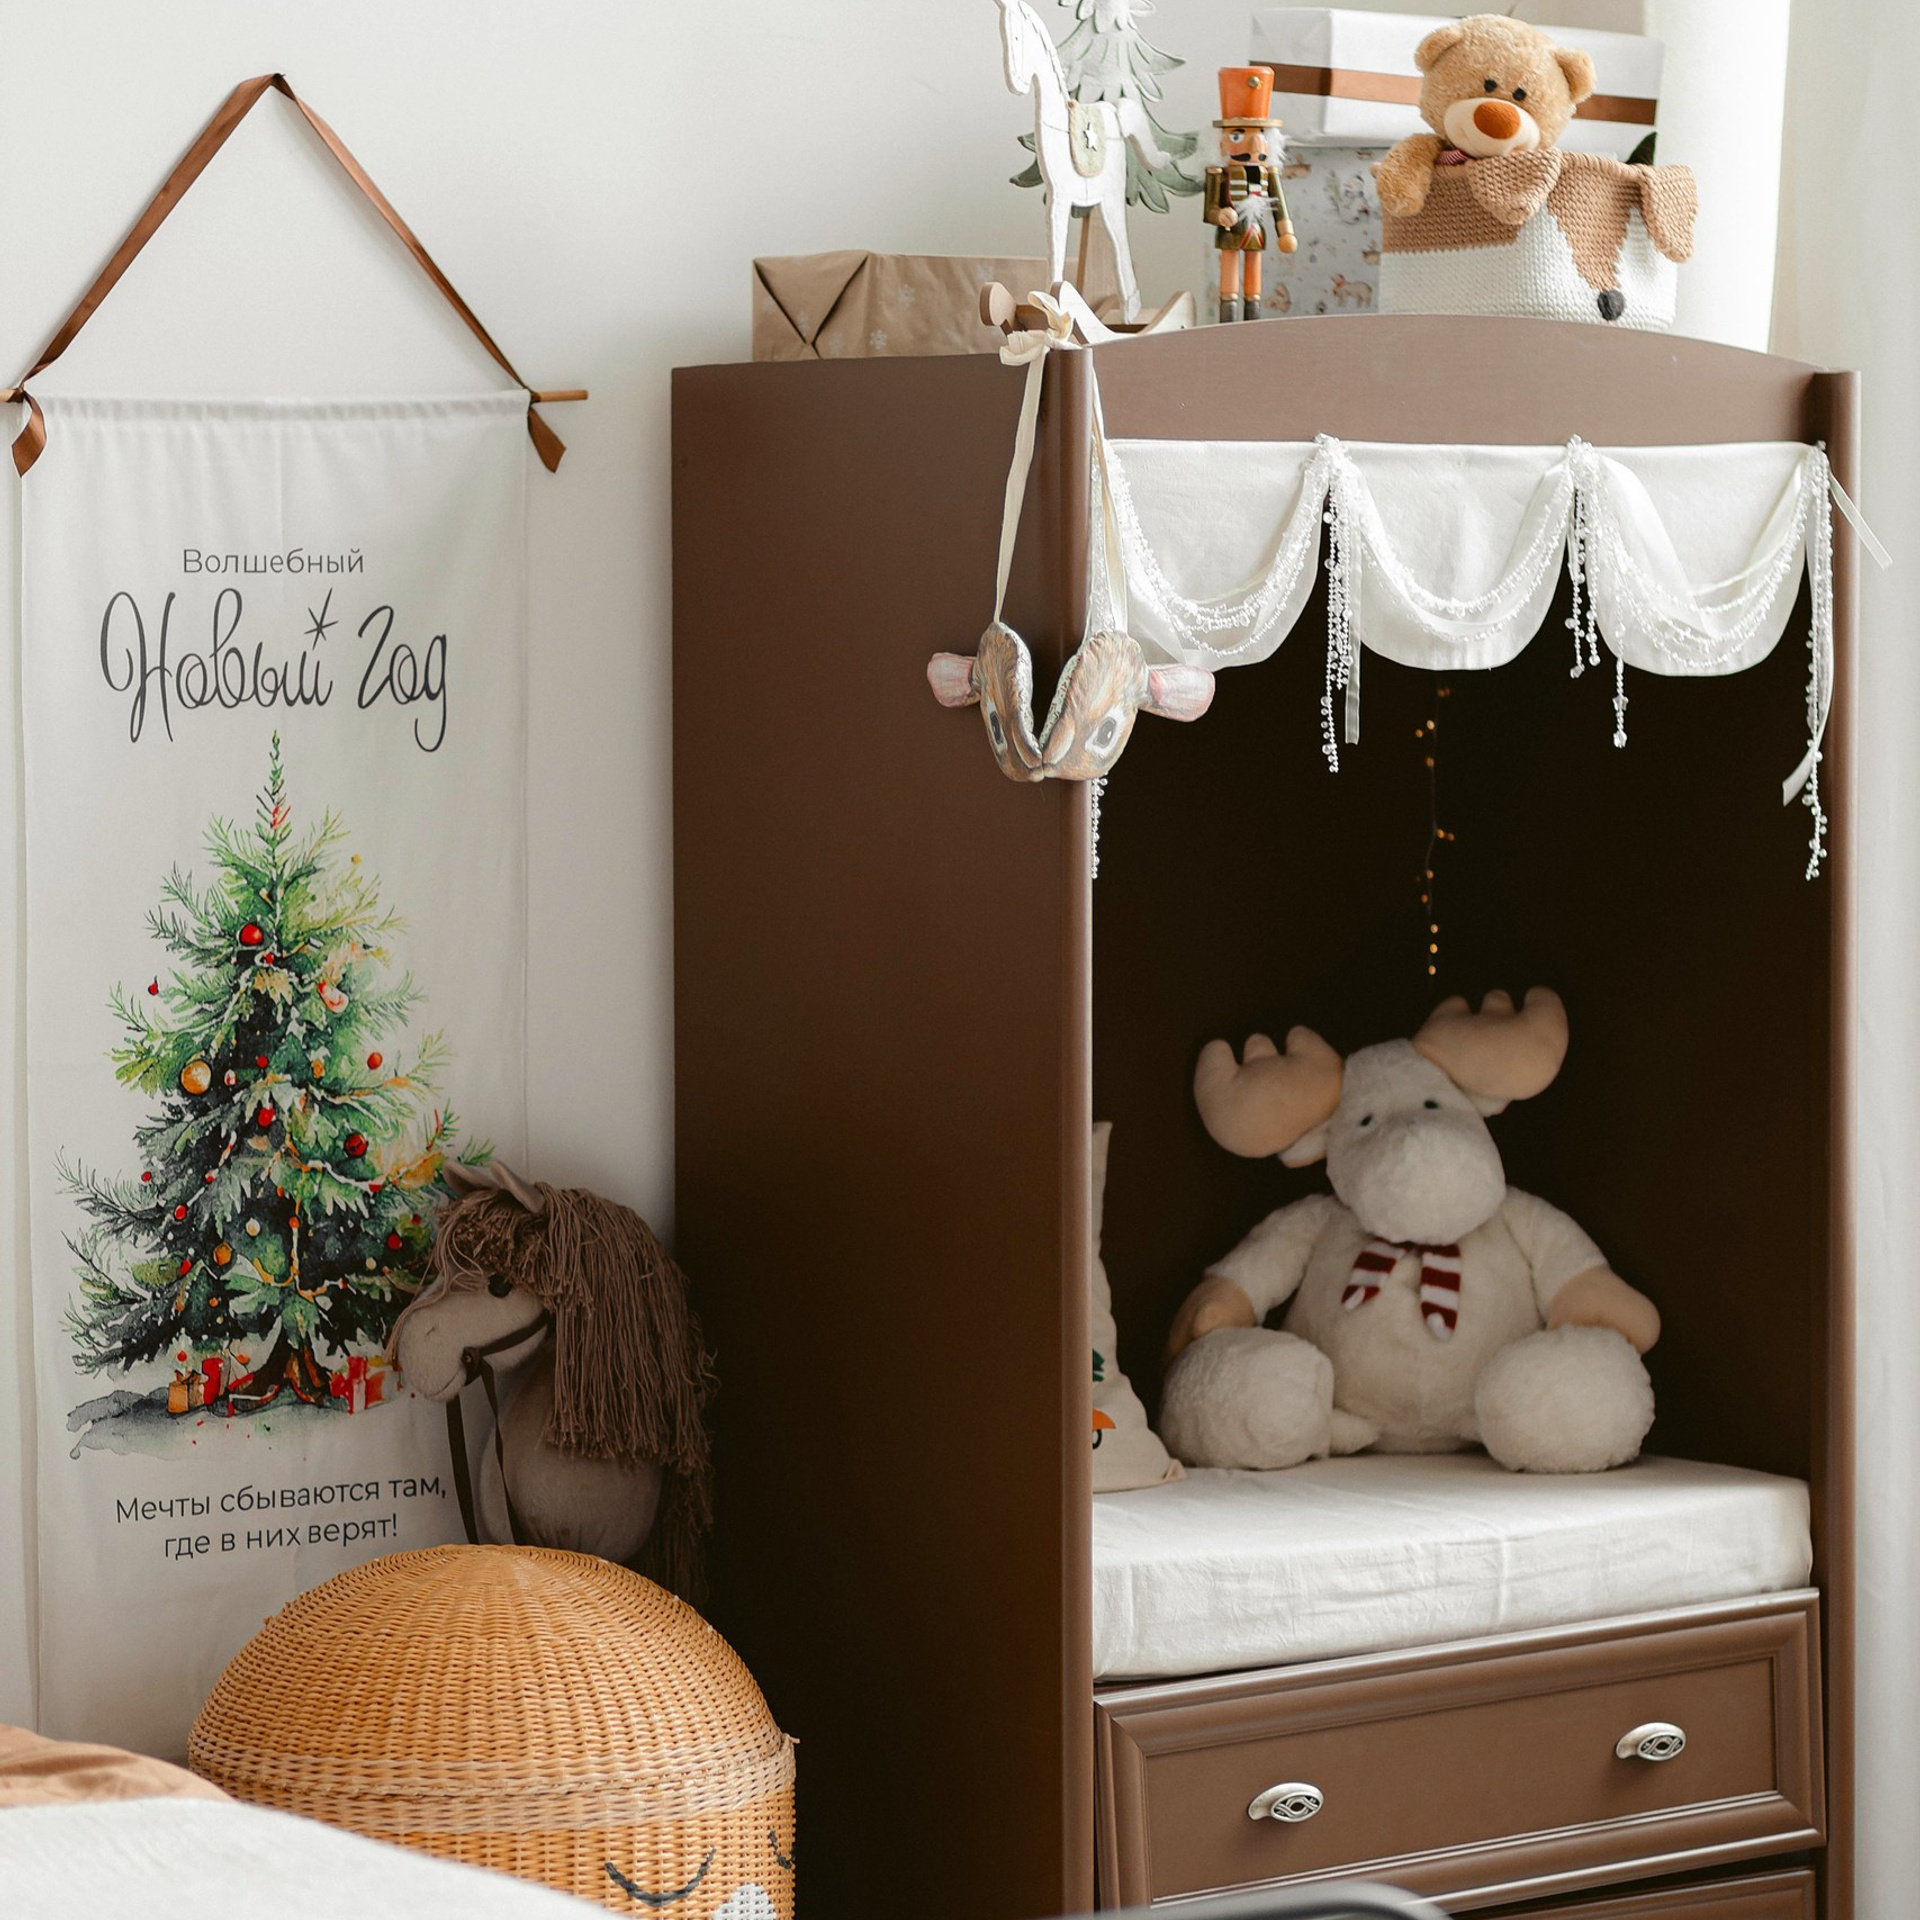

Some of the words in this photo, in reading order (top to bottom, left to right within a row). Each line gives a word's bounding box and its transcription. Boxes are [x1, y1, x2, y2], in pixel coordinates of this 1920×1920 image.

[182, 547, 365, 574] Волшебный
[100, 587, 338, 744] Новый
[357, 604, 447, 753] Год
[115, 1494, 211, 1523] Мечты
[219, 1480, 380, 1513] сбываются
[387, 1475, 447, 1499] там,
[164, 1536, 211, 1562] где
[221, 1532, 236, 1552] в
[246, 1525, 301, 1550] них
[307, 1513, 398, 1548] верят!
